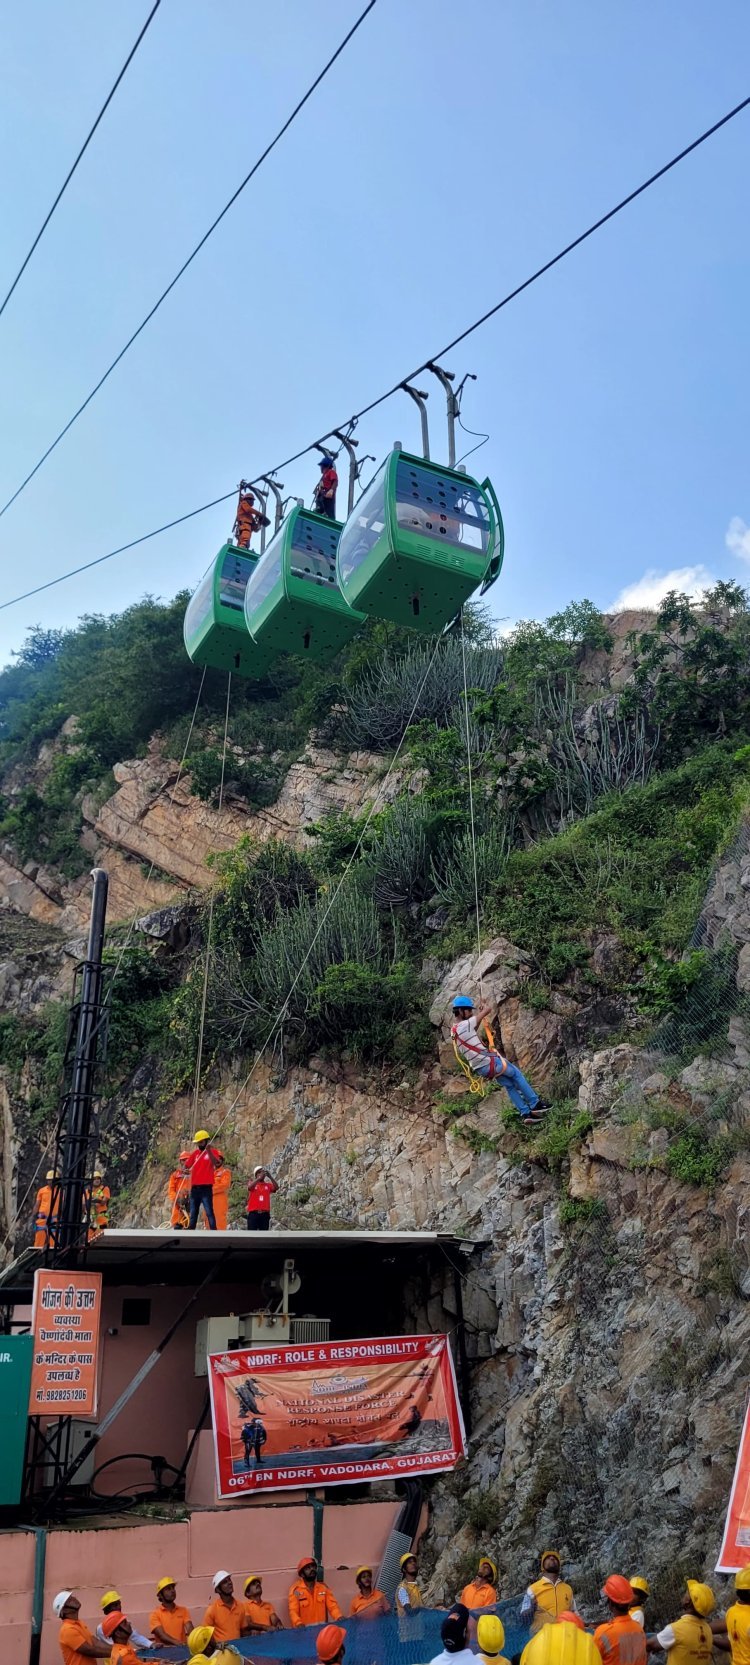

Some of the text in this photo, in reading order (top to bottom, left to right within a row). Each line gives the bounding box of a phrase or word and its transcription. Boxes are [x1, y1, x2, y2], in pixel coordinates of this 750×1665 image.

[42, 1284, 95, 1309] भोजन की उत्तम
[54, 1315, 80, 1325] व्यवस्था
[75, 1332, 92, 1341] माता
[36, 1353, 44, 1364] के
[68, 1353, 77, 1364] के
[77, 1355, 92, 1364] पास
[247, 1342, 419, 1367] NDRF: ROLE & RESPONSIBILITY
[74, 1368, 80, 1381] है
[46, 1389, 87, 1401] 9828251206
[276, 1390, 406, 1407] NATIONAL DISASTER
[287, 1400, 397, 1414] RESPONSE FORCE
[255, 1472, 273, 1482] BN
[277, 1468, 316, 1480] NDRF,
[319, 1461, 394, 1476] VADODARA,
[397, 1451, 458, 1467] GUJARAT
